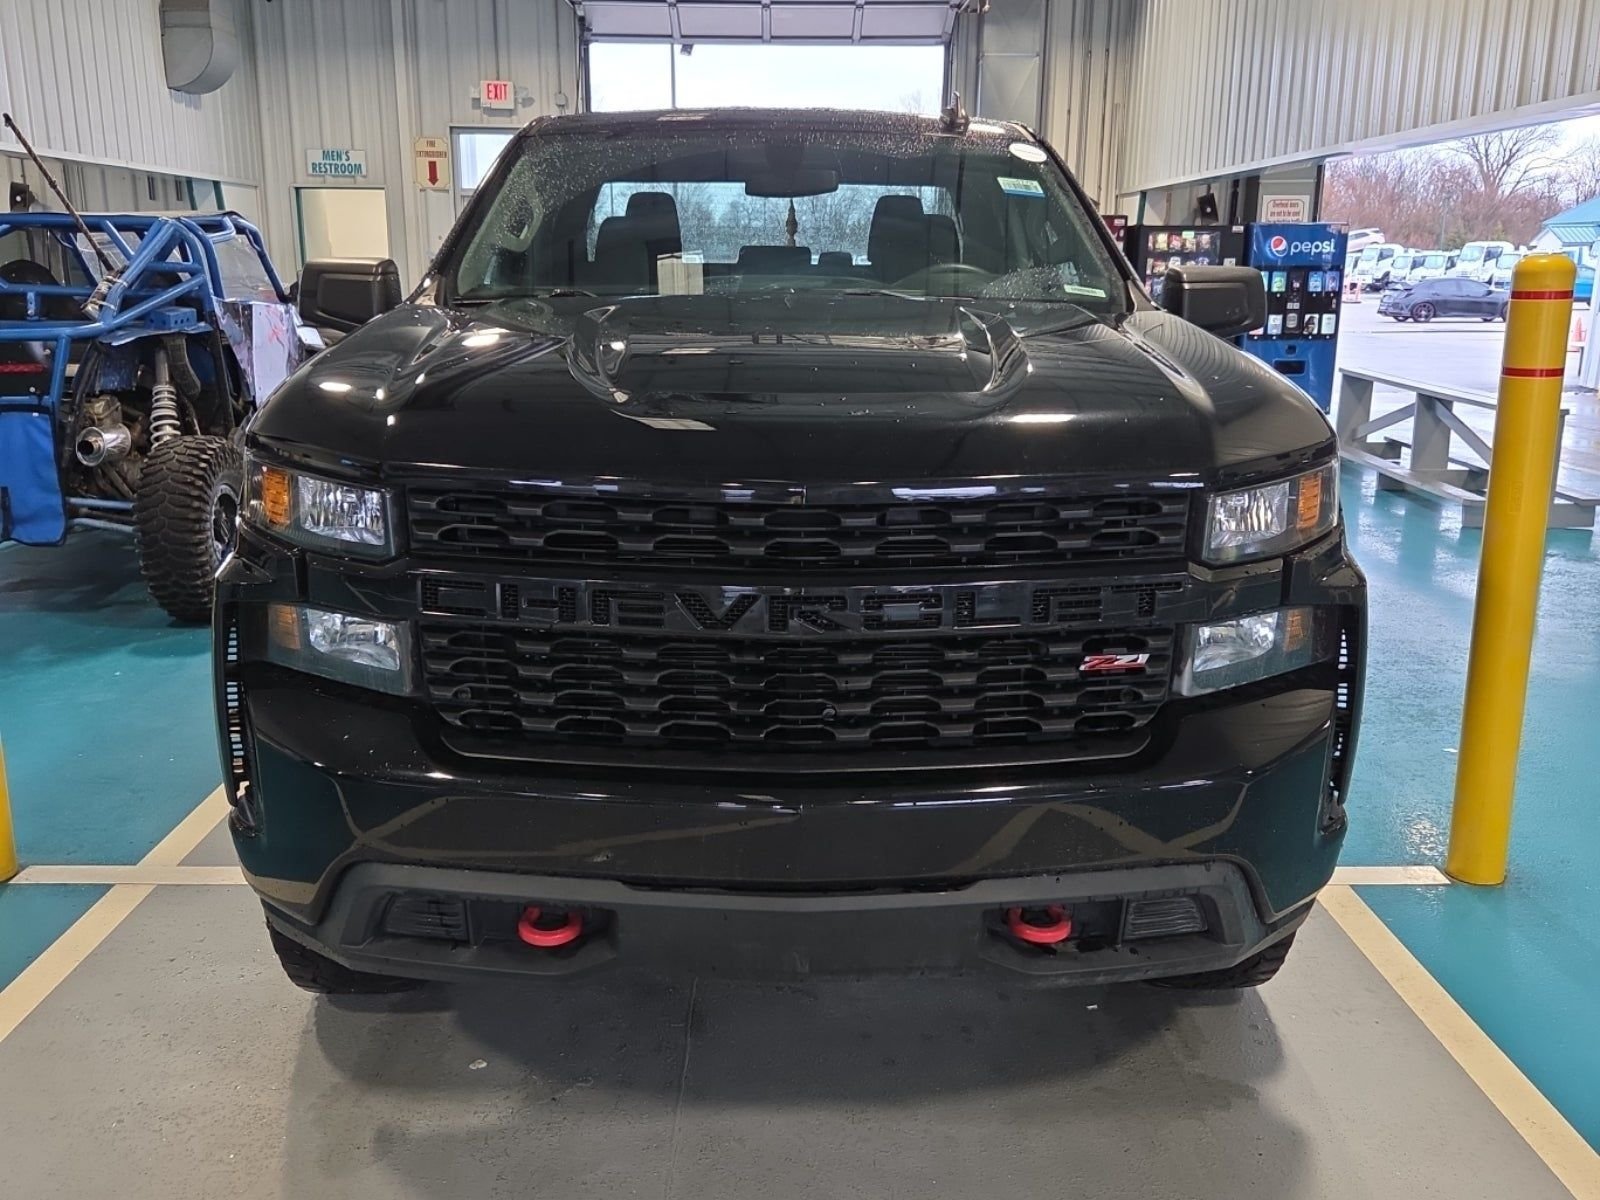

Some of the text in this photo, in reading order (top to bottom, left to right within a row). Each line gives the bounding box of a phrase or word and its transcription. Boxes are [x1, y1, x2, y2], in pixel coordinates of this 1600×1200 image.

[487, 83, 508, 100] EXIT
[322, 150, 350, 161] MEN'S
[311, 162, 363, 175] RESTROOM
[1290, 238, 1336, 256] pepsi
[419, 575, 1186, 633] CHEVROLET
[1079, 653, 1151, 671] Z71
